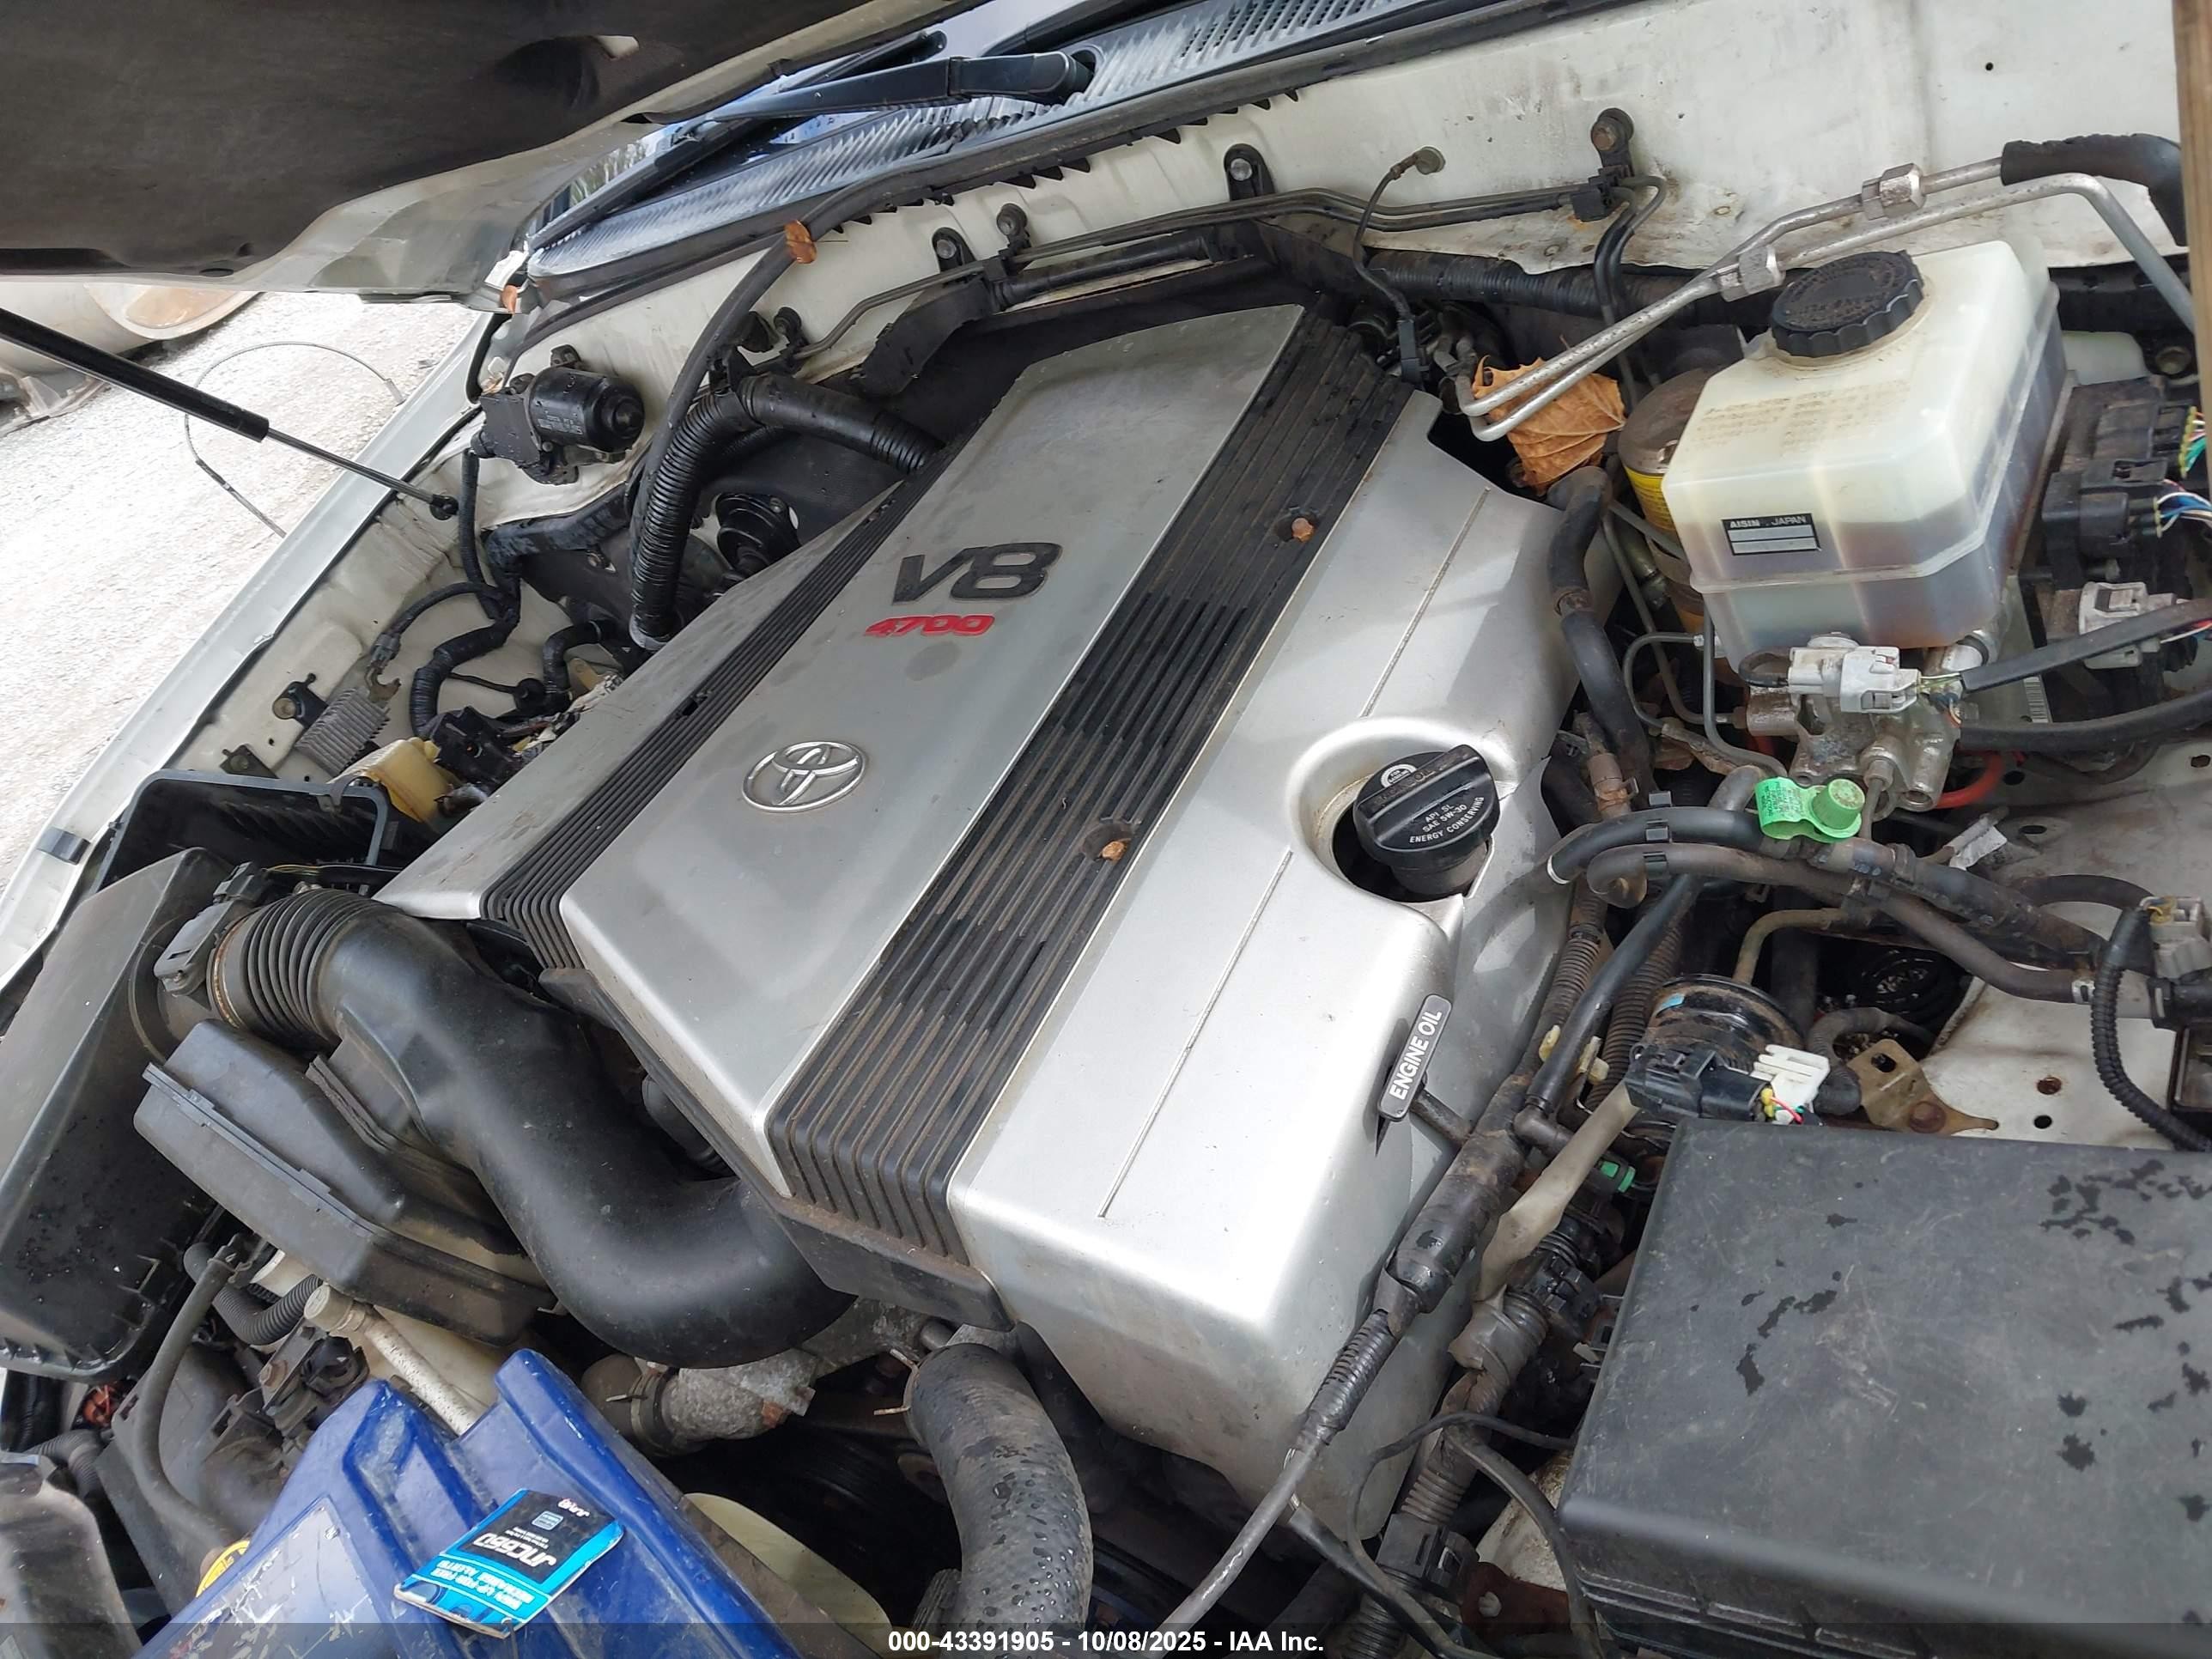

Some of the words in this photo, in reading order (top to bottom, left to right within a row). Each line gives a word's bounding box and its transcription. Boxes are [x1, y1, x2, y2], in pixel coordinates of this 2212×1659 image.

[1729, 519, 1760, 529] AISIN
[1771, 515, 1807, 526] JAPAN
[892, 542, 1063, 606] V8
[865, 614, 996, 637] 4700
[1409, 830, 1444, 843] ENERGY
[1446, 796, 1485, 833] CONSERVING
[1422, 820, 1441, 833] SAE
[1439, 804, 1468, 822] 5W-30
[1425, 812, 1440, 823] API
[1441, 804, 1455, 812] SL
[1389, 1036, 1430, 1101] ENGINE
[1418, 1010, 1443, 1036] OIL
